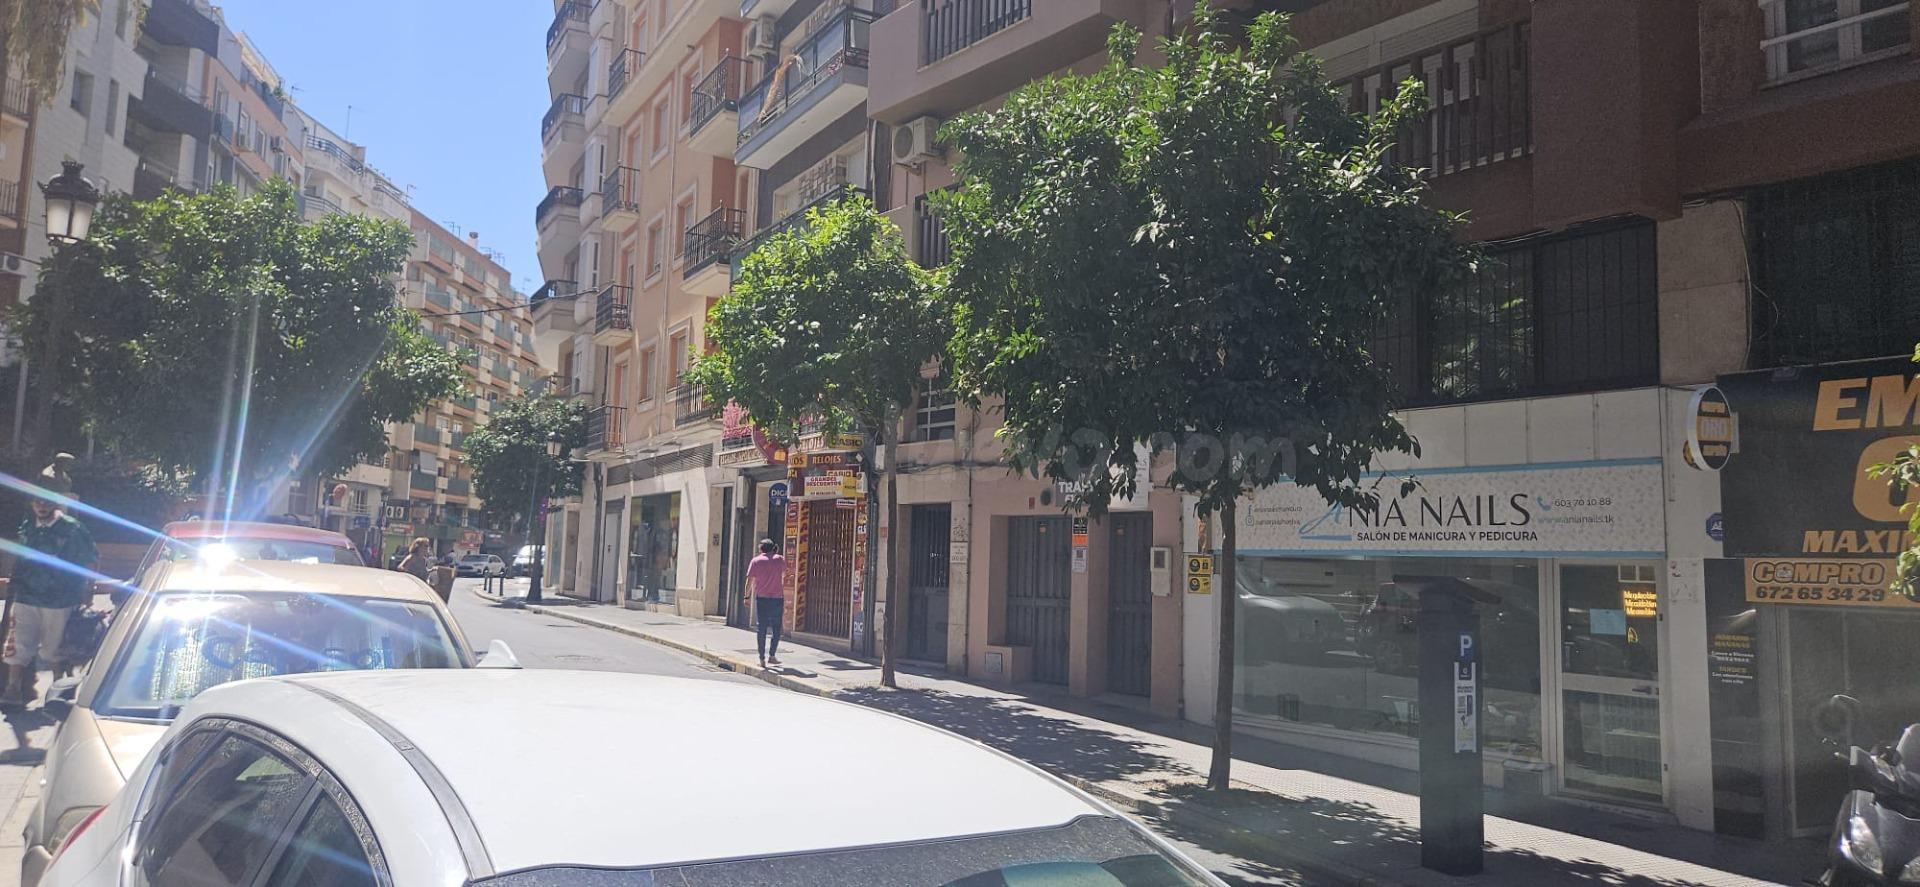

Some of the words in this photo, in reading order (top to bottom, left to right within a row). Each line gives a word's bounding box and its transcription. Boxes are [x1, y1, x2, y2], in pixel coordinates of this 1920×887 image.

[812, 455, 841, 466] RELOJES
[1599, 497, 1612, 506] 88
[1420, 493, 1530, 528] NAILS
[1357, 531, 1390, 542] SALÓN
[1393, 532, 1406, 541] DE
[1409, 532, 1467, 541] MANICURA
[1468, 532, 1477, 541] Y
[1479, 531, 1538, 541] PEDICURA
[1752, 561, 1886, 585] COMPRO
[1756, 586, 1794, 599] 672
[1797, 586, 1822, 600] 65
[1825, 587, 1855, 600] 34
[1857, 587, 1886, 602] 29
[1460, 635, 1473, 656] P
